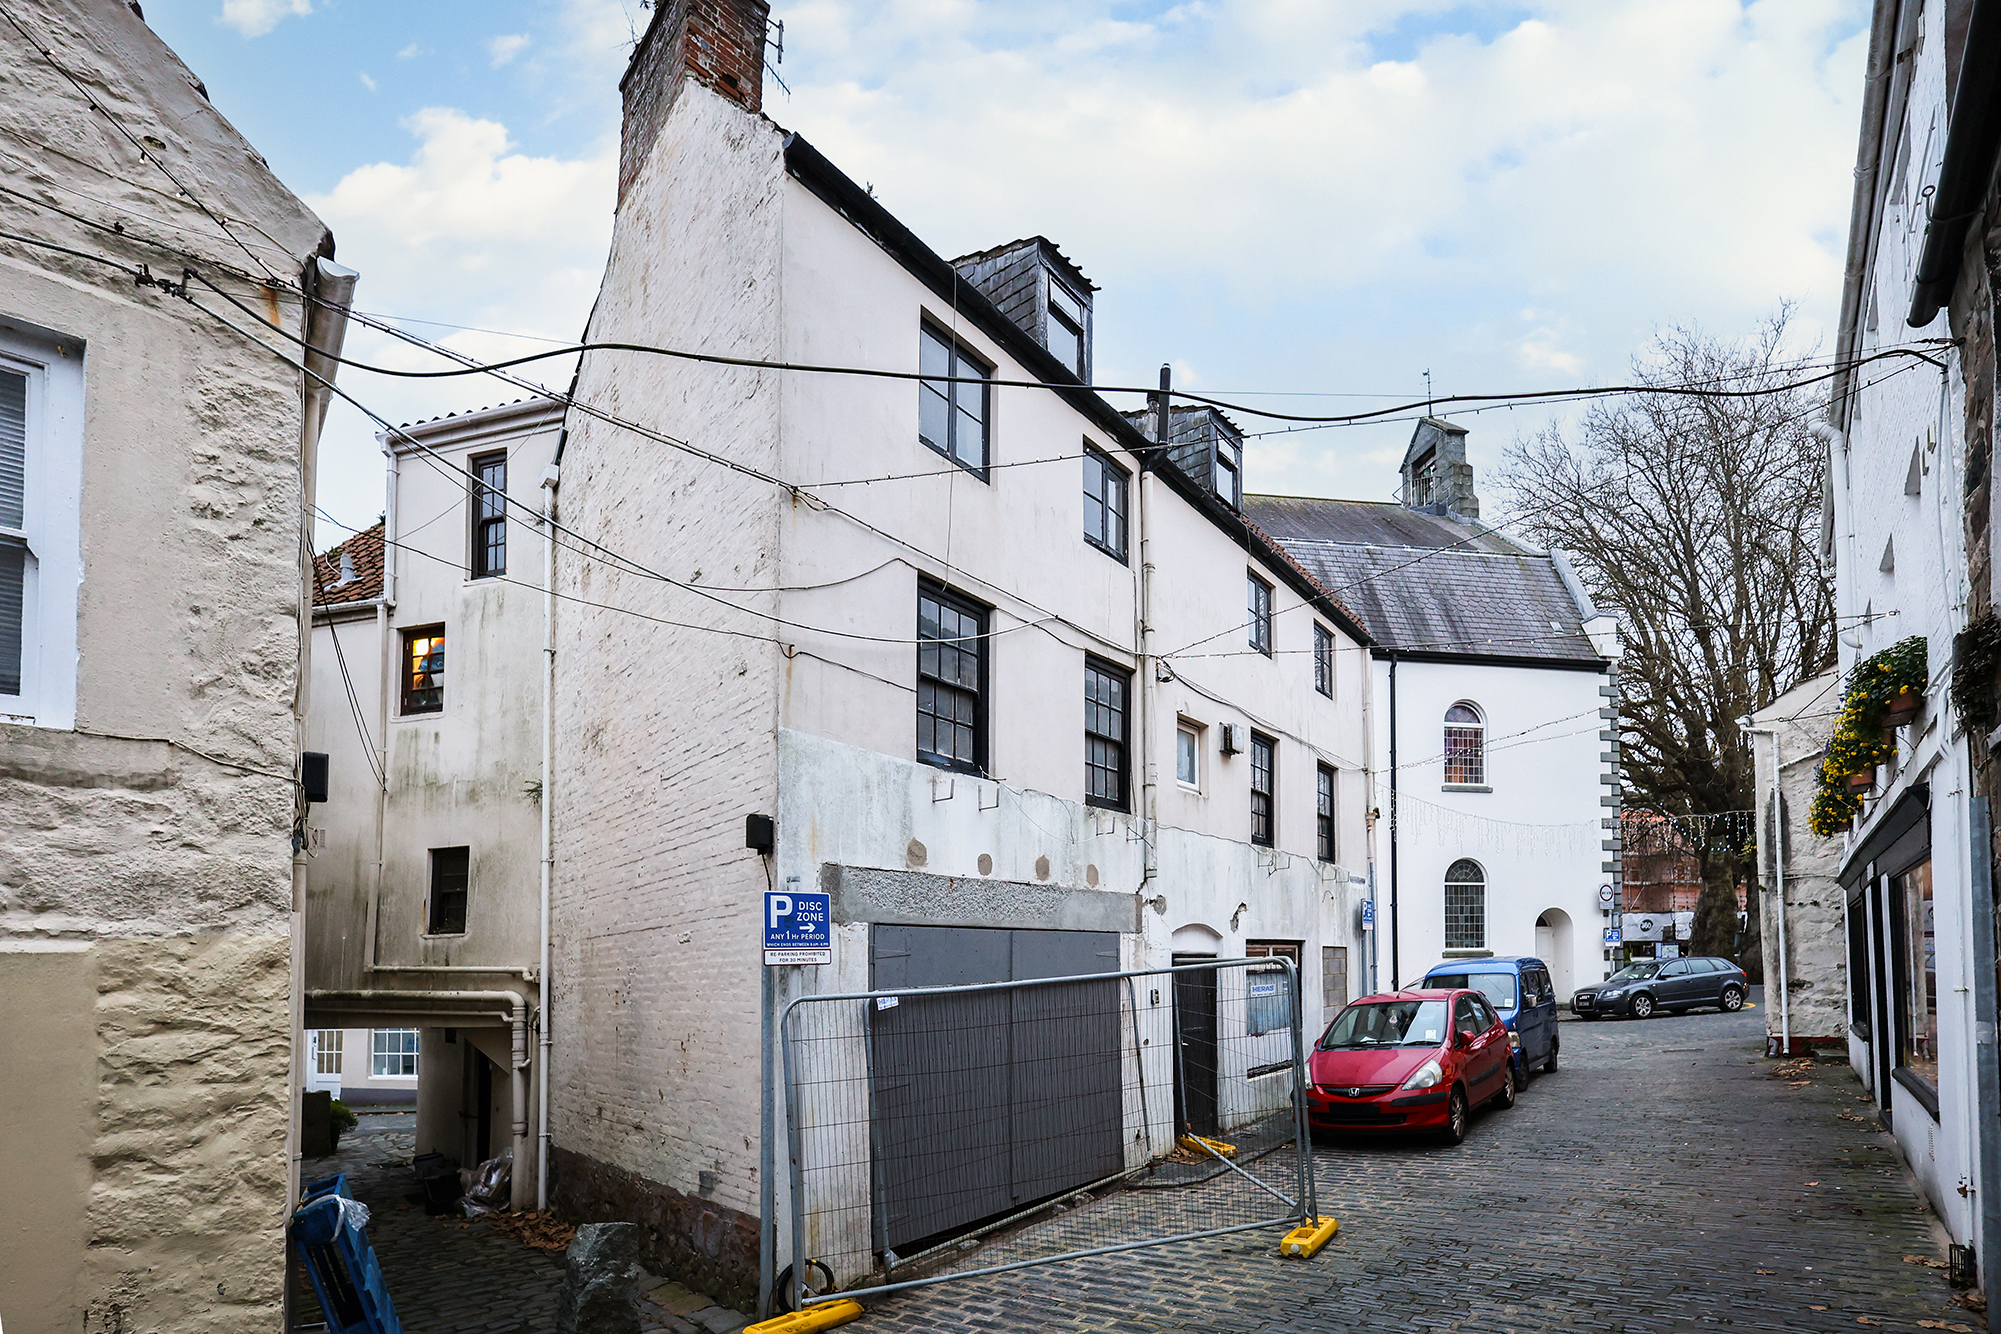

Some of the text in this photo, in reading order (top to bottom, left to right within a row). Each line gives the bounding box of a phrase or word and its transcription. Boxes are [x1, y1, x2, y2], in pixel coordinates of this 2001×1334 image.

[798, 901, 822, 911] DISC
[770, 895, 793, 928] P
[796, 912, 824, 922] ZONE
[786, 930, 790, 940] 1
[1606, 930, 1612, 939] P
